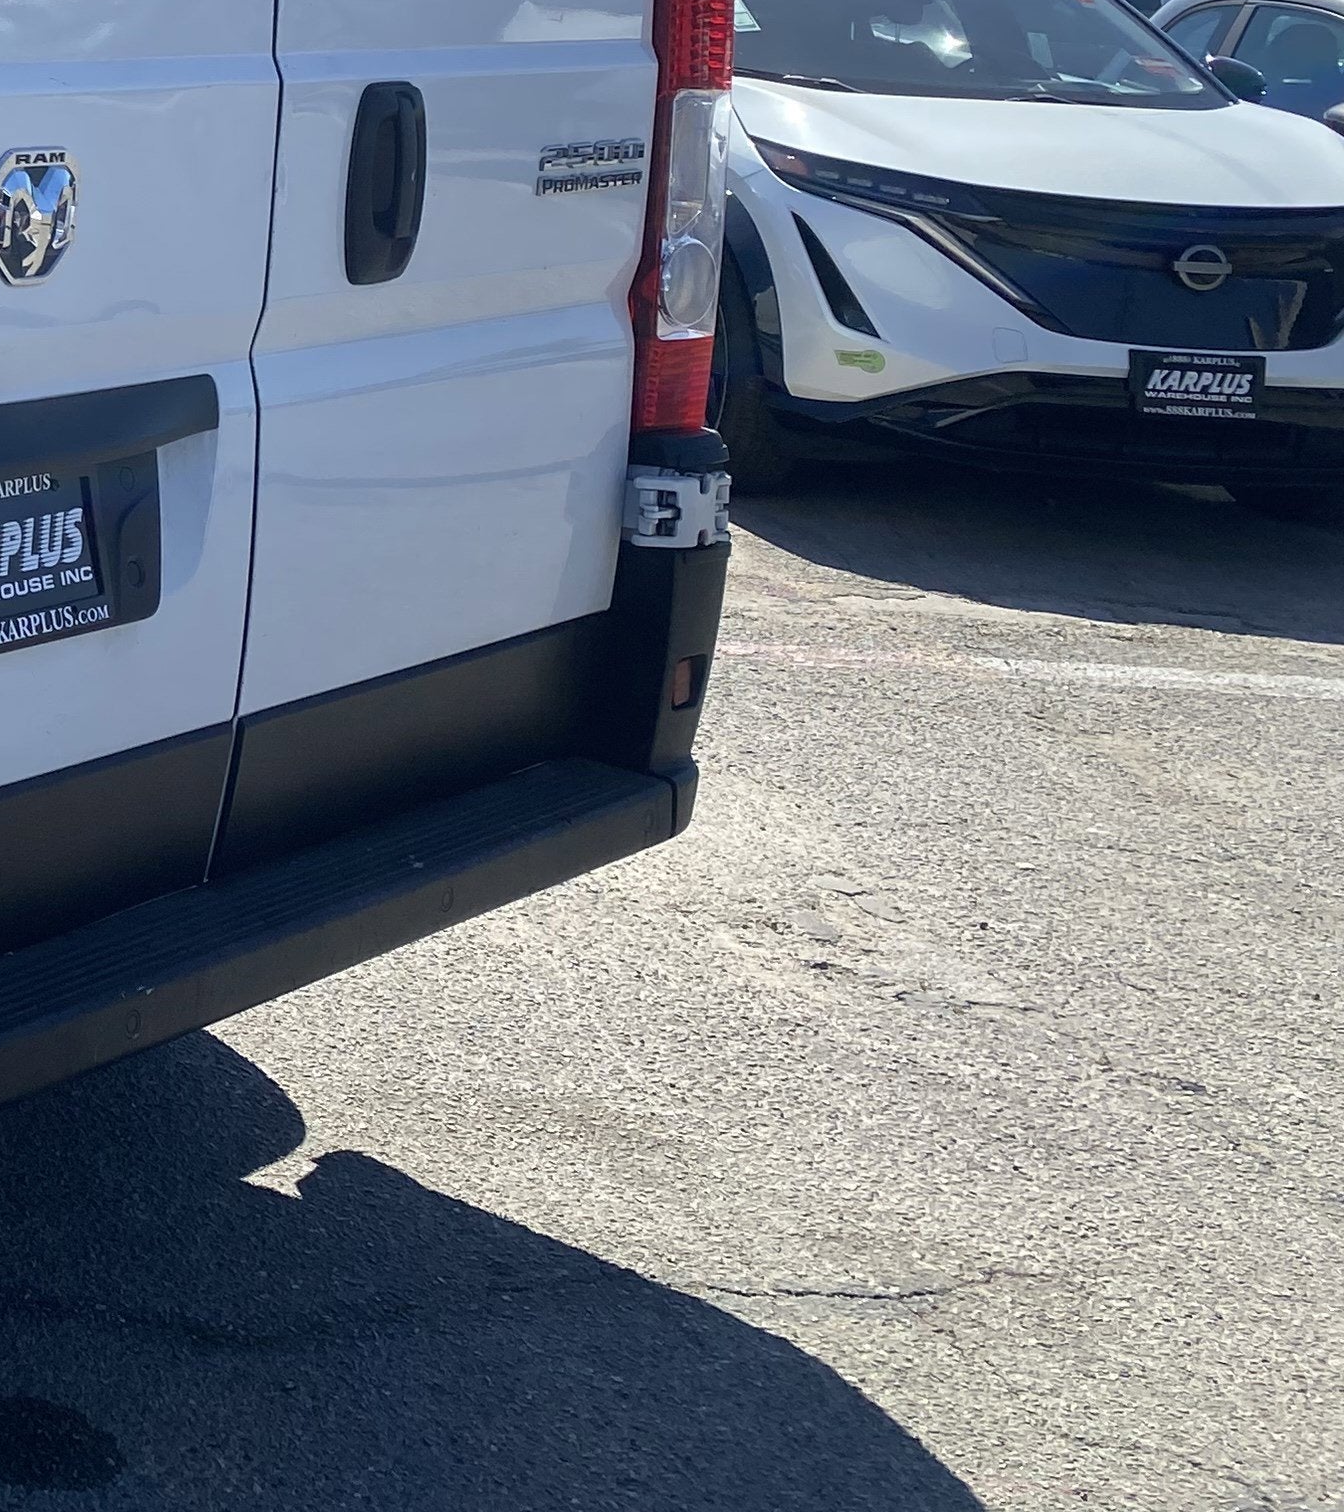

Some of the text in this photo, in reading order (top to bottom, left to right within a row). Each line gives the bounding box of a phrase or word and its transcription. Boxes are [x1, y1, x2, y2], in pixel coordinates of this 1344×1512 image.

[15, 152, 66, 165] RAM
[538, 170, 644, 195] PROMASTER
[1147, 369, 1254, 395] KARPLUS
[1144, 391, 1253, 403] WAREHOUSE INC
[60, 566, 94, 586] INC
